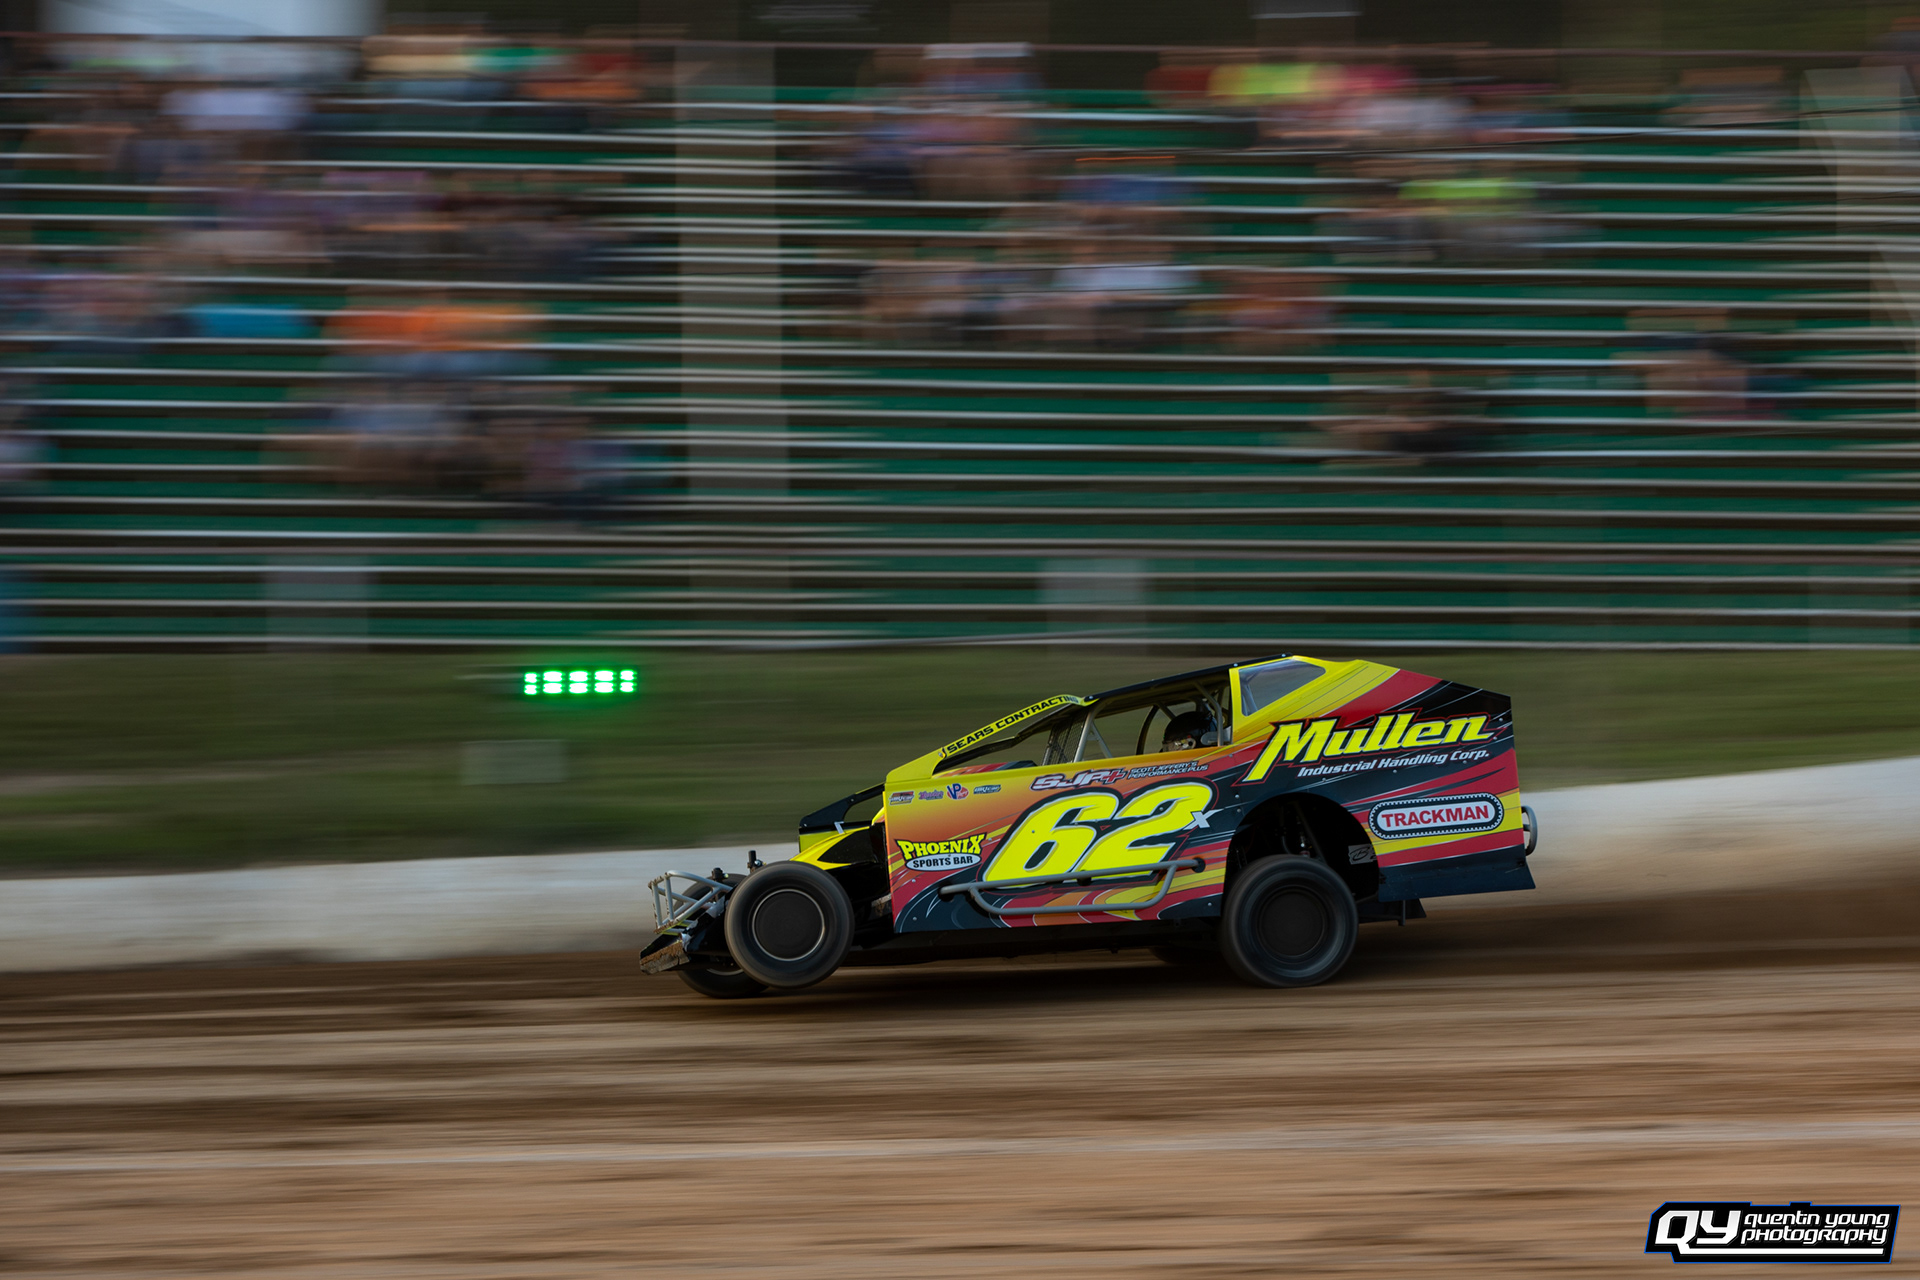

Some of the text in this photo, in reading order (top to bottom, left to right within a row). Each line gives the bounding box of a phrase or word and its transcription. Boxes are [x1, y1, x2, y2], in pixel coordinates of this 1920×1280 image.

[947, 695, 1079, 753] SEARS CONTRACTING
[1242, 712, 1494, 782] Mullen
[1128, 764, 1209, 779] PERFORMANCE PLUS
[1297, 749, 1490, 777] Industrial Handling Corp.
[1381, 805, 1489, 828] TRACKMAN
[896, 833, 985, 861] PHOENIX
[913, 856, 973, 868] SPORTS BAR
